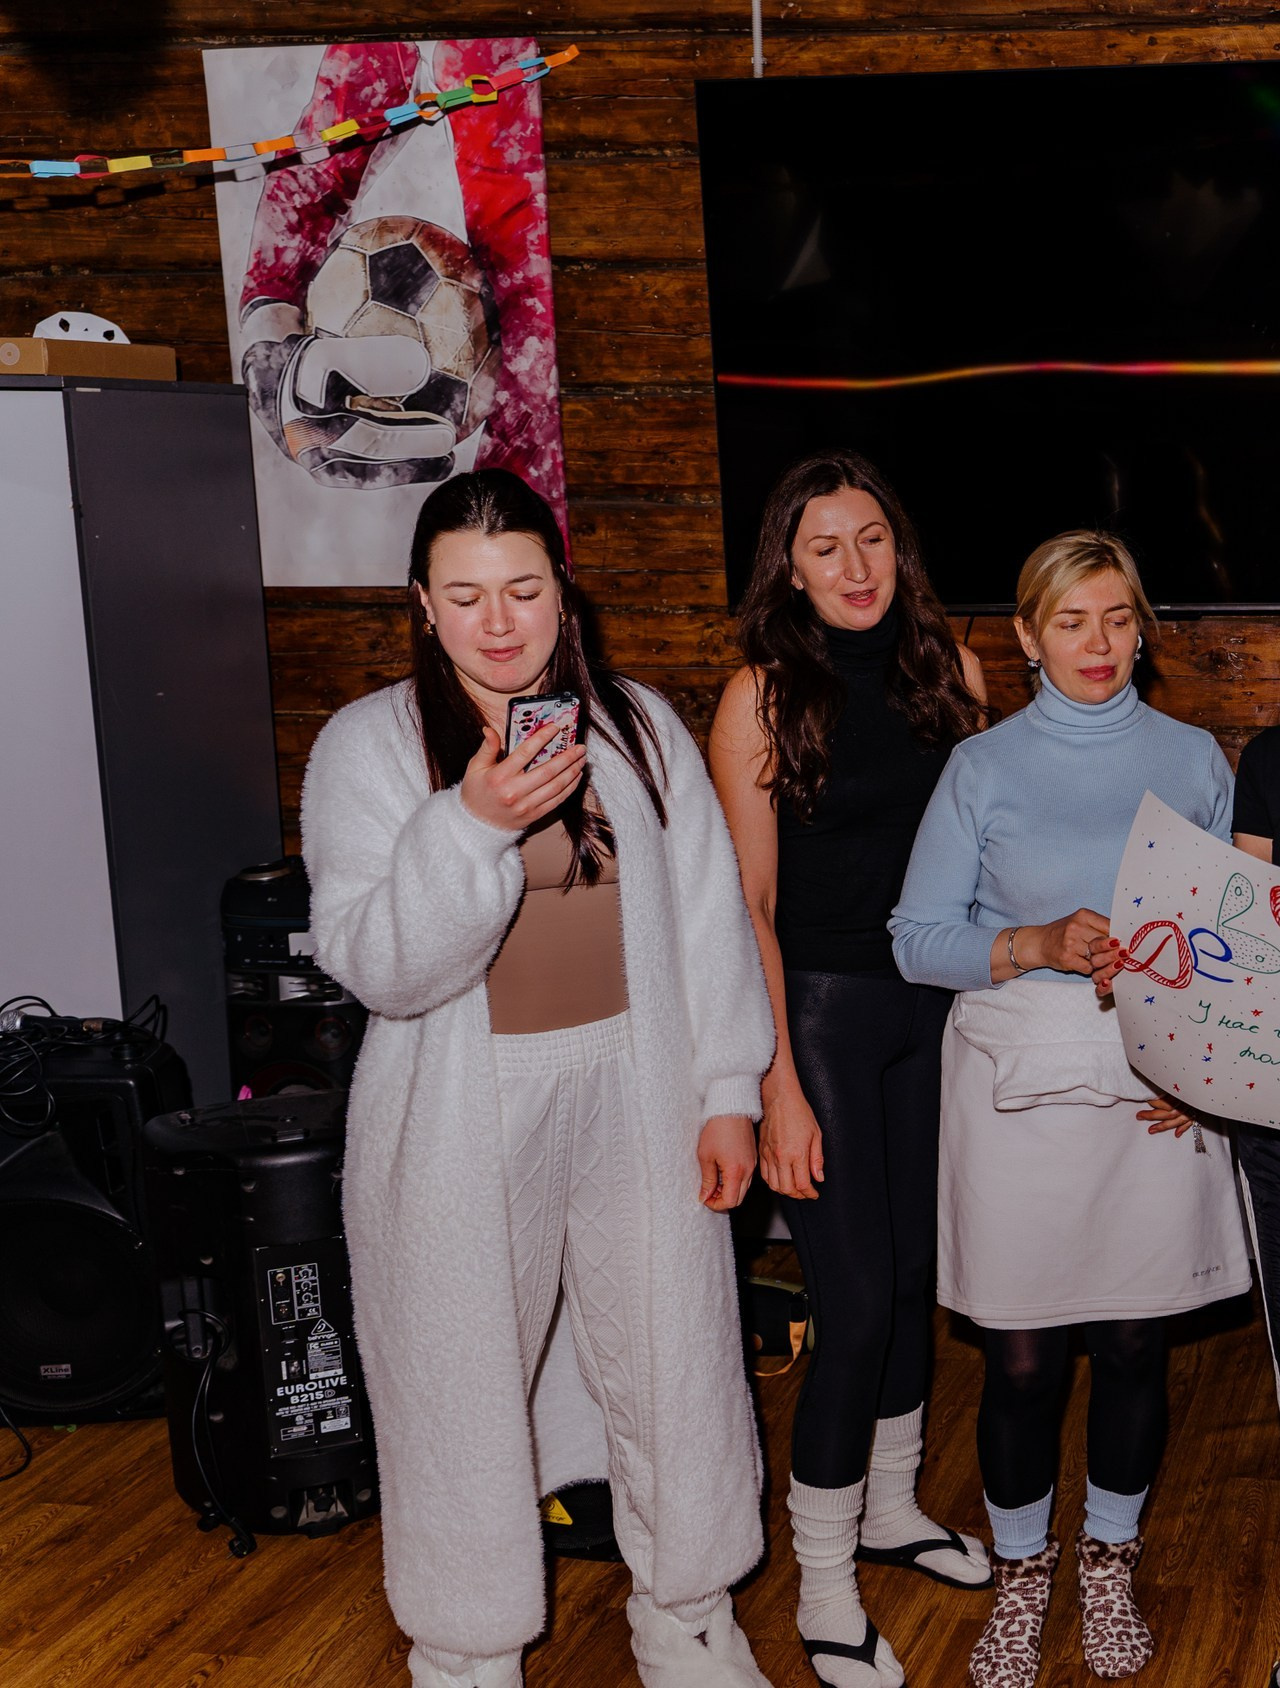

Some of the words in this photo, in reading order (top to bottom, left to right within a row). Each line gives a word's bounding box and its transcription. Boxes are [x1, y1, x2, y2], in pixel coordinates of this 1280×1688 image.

[1188, 1000, 1212, 1024] У
[1218, 1014, 1260, 1034] нас
[276, 1375, 348, 1397] EUROLIVE
